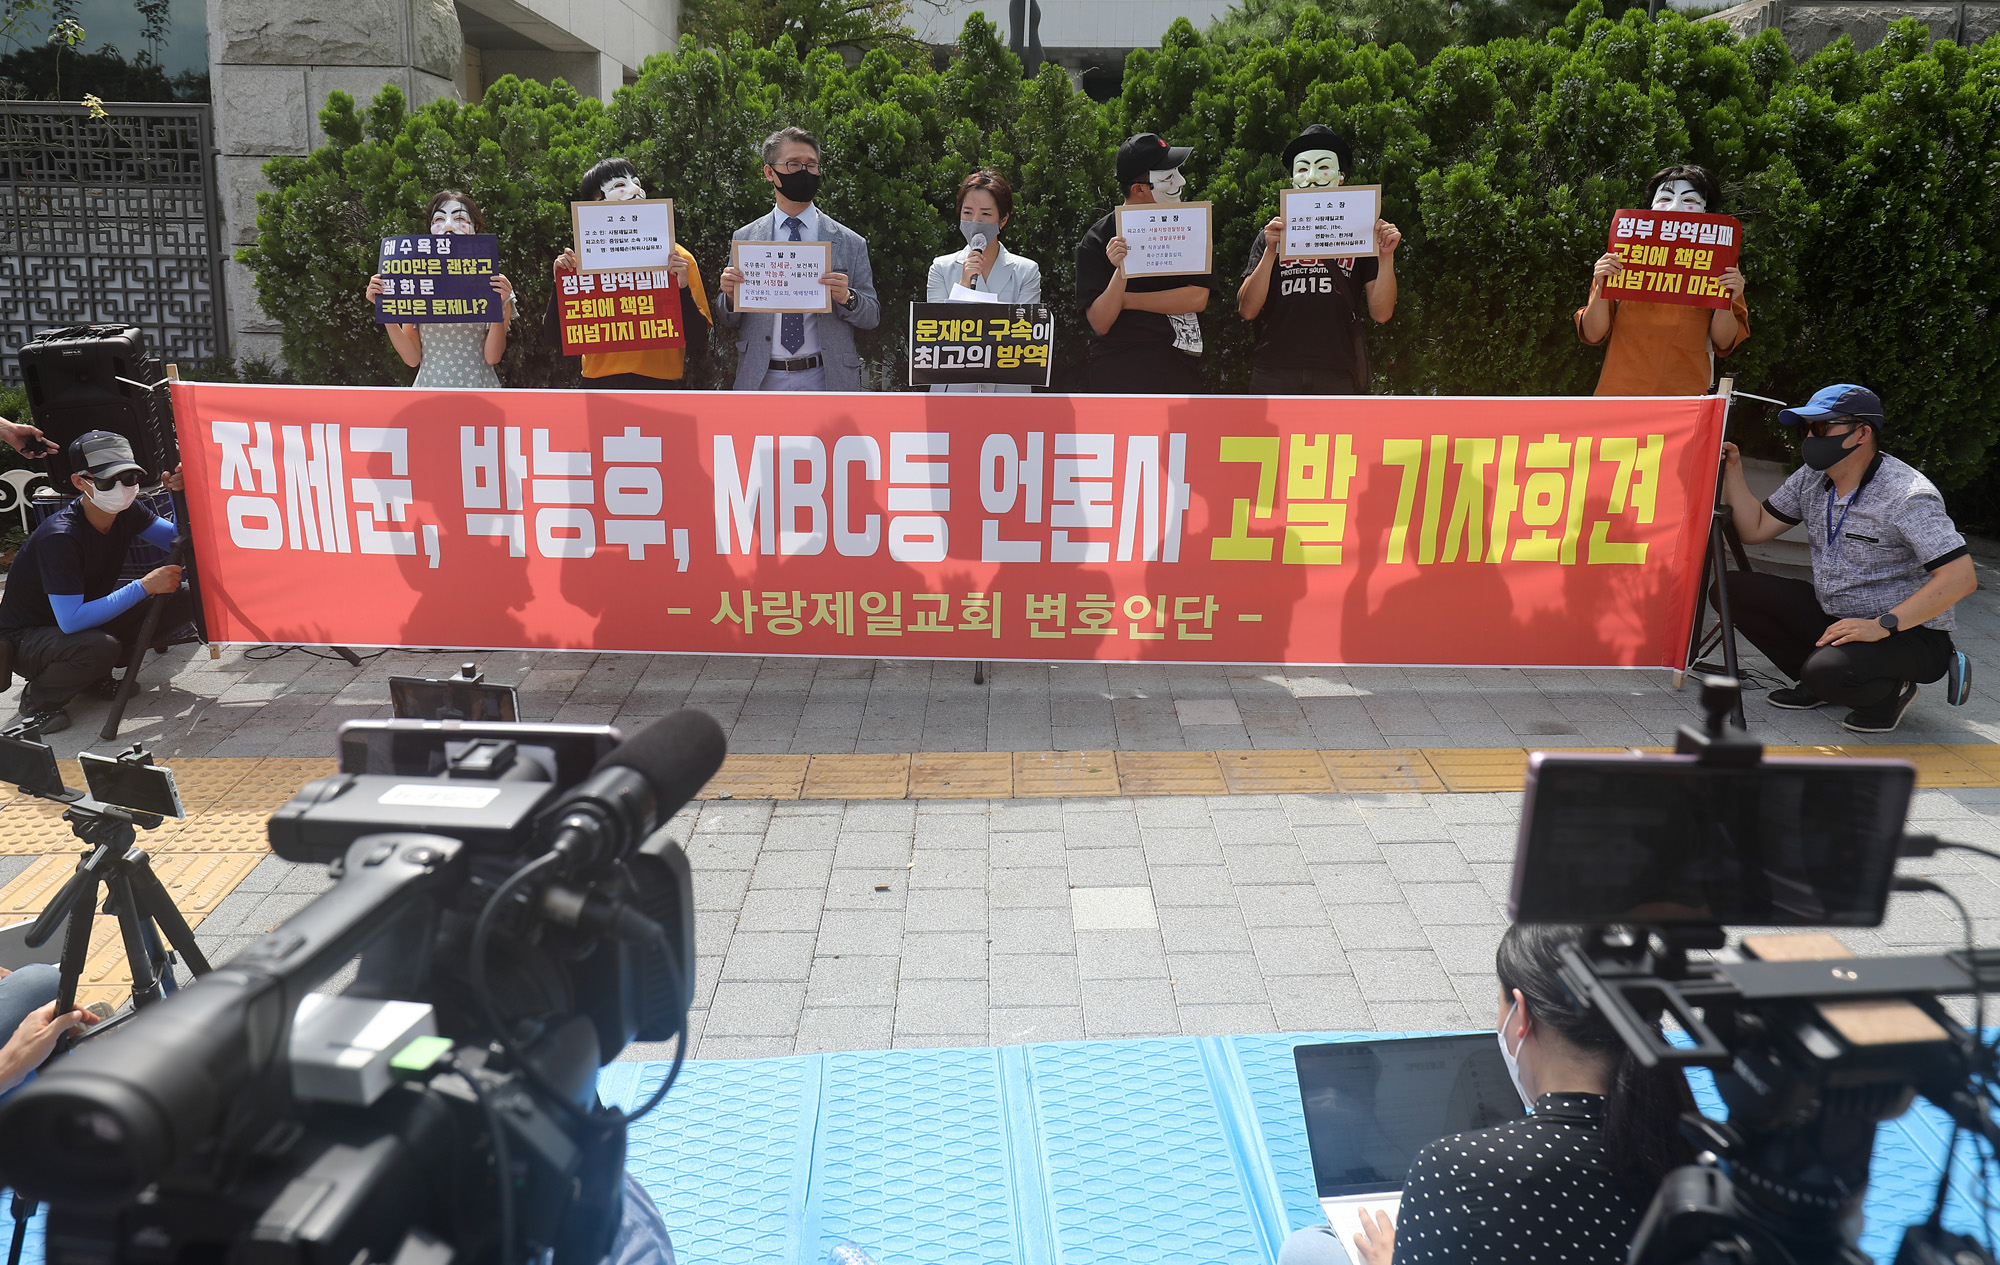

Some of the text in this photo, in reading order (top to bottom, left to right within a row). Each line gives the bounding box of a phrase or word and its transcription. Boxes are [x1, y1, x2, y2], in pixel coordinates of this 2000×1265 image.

[1616, 217, 1734, 247] 정부 방역실패
[381, 258, 493, 275] 300만은 괜찮고
[1280, 266, 1328, 277] PROTECT SOUTH
[1674, 248, 1714, 271] 책임
[561, 270, 670, 295] 정부 방역실패
[1281, 277, 1332, 296] 0415
[382, 298, 488, 316] 국민은 문제냐?
[564, 295, 654, 320] 교회에 책임
[566, 318, 680, 344] 떠넘기지 마라.
[916, 318, 1050, 342] 문재인 구속이
[914, 344, 1048, 370] 최고의 방역
[211, 421, 1666, 573] 정세균, 박능후, MBC등 언론사 고발 기자회견
[710, 590, 1002, 639] 사랑제일교회
[1026, 593, 1219, 642] 변호인단
